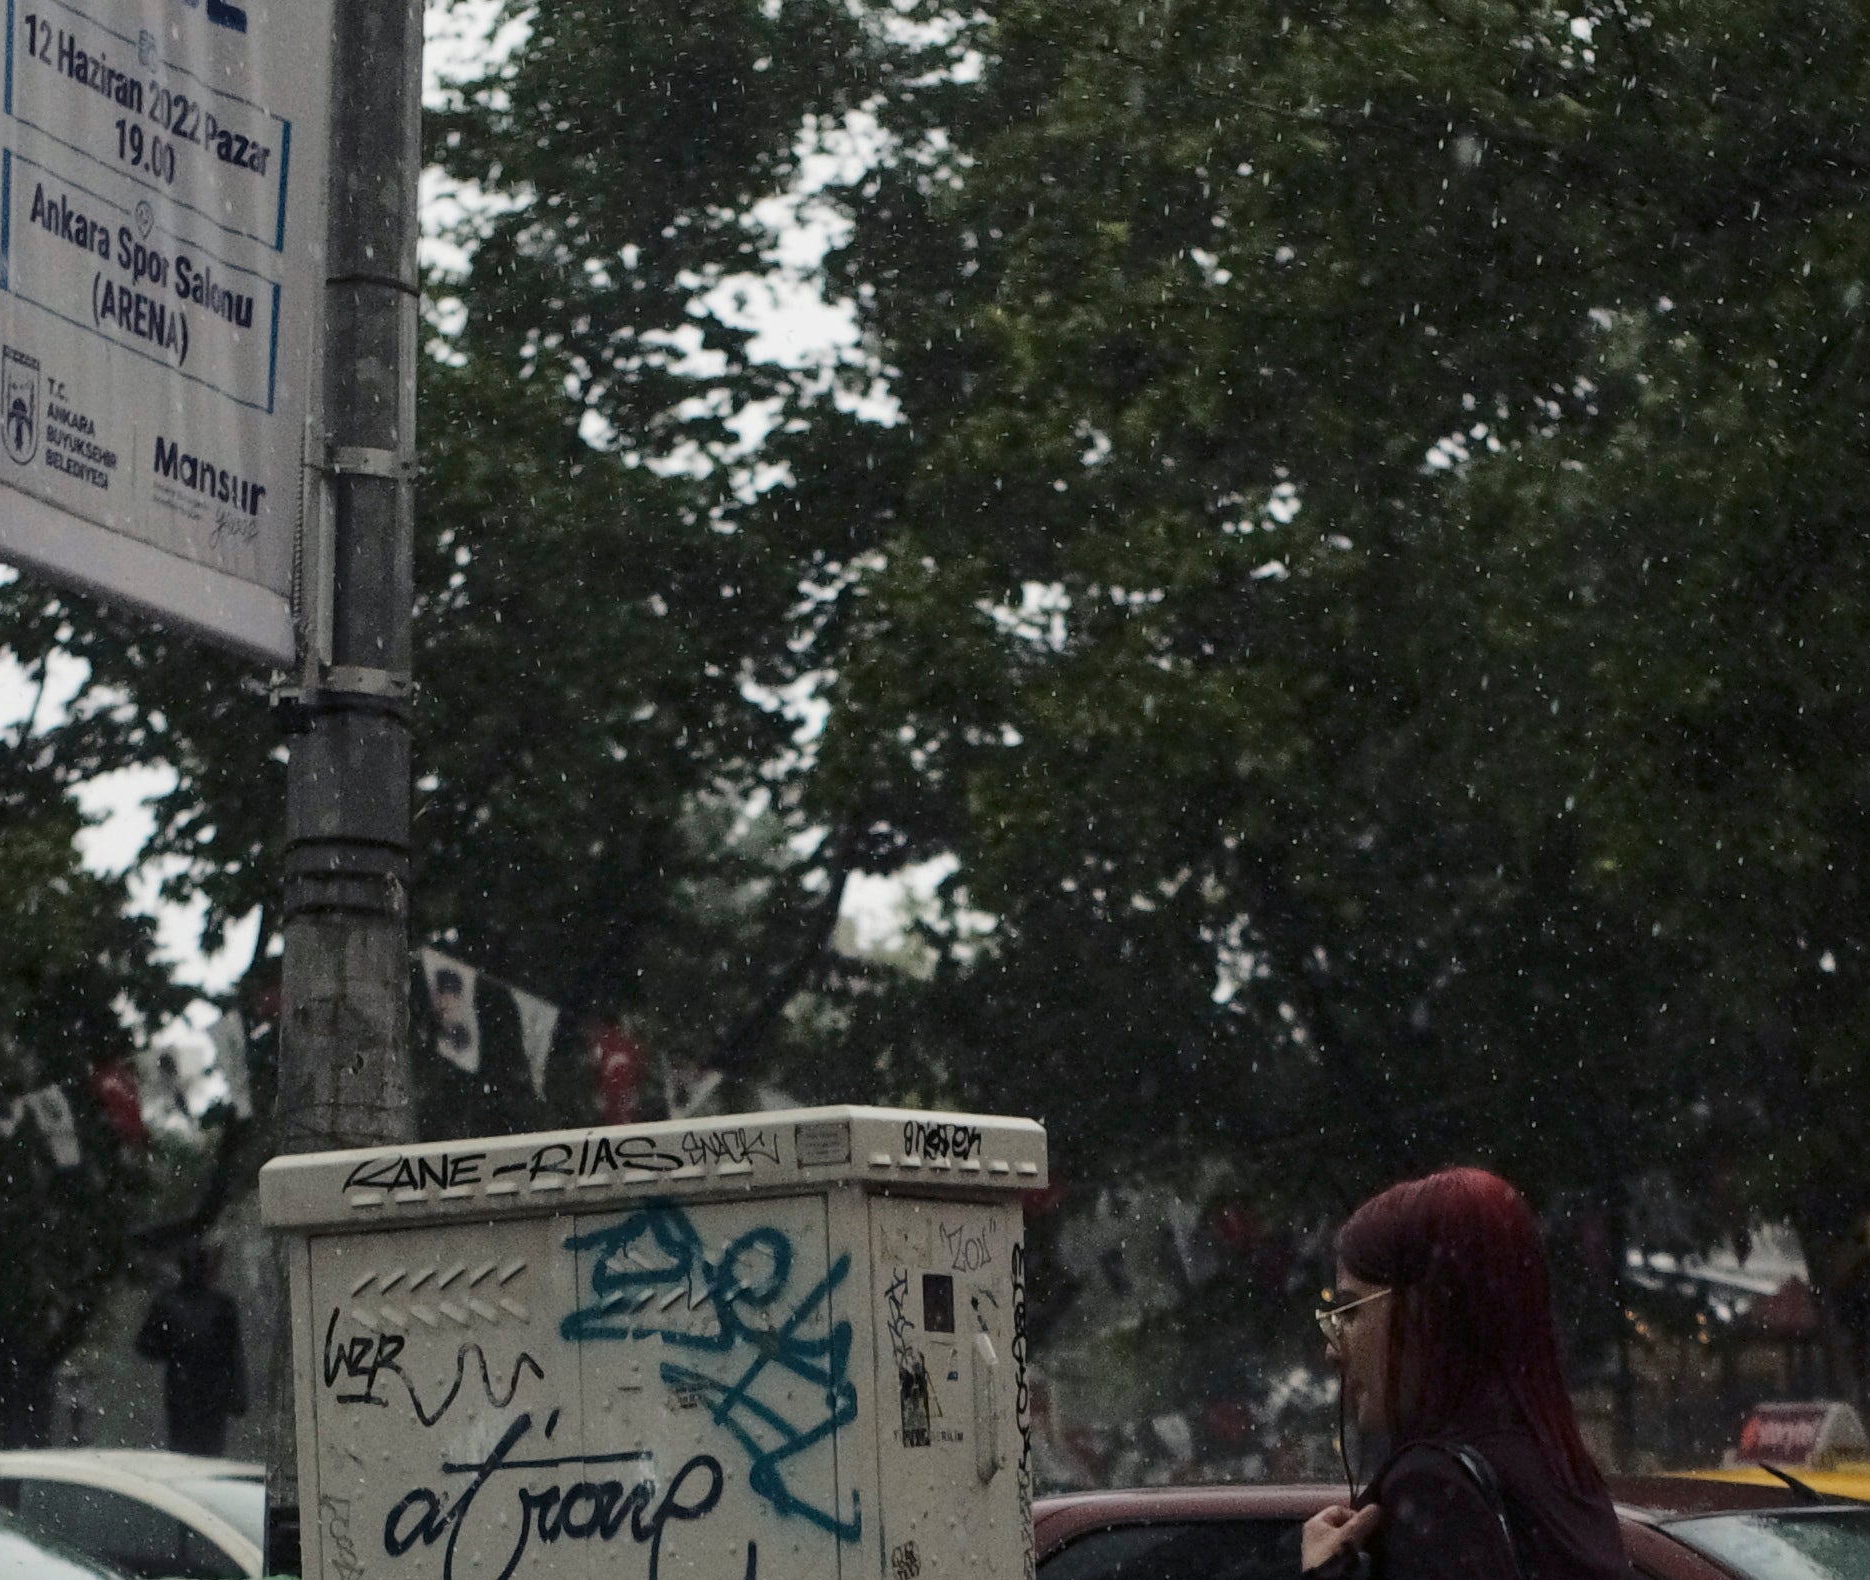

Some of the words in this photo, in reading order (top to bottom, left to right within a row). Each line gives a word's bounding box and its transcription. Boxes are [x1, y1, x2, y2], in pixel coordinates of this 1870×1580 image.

[26, 14, 51, 65] 12
[58, 29, 142, 114] Haziran
[149, 80, 200, 143] 2022
[204, 113, 270, 176] Pazar
[116, 118, 175, 185] 19.00
[30, 183, 110, 259] Ankara
[117, 227, 169, 288] Spor
[175, 256, 253, 328] Salonu
[93, 271, 188, 368] (ARENA)
[47, 402, 95, 437] ANKARA
[153, 436, 266, 516] Mansur
